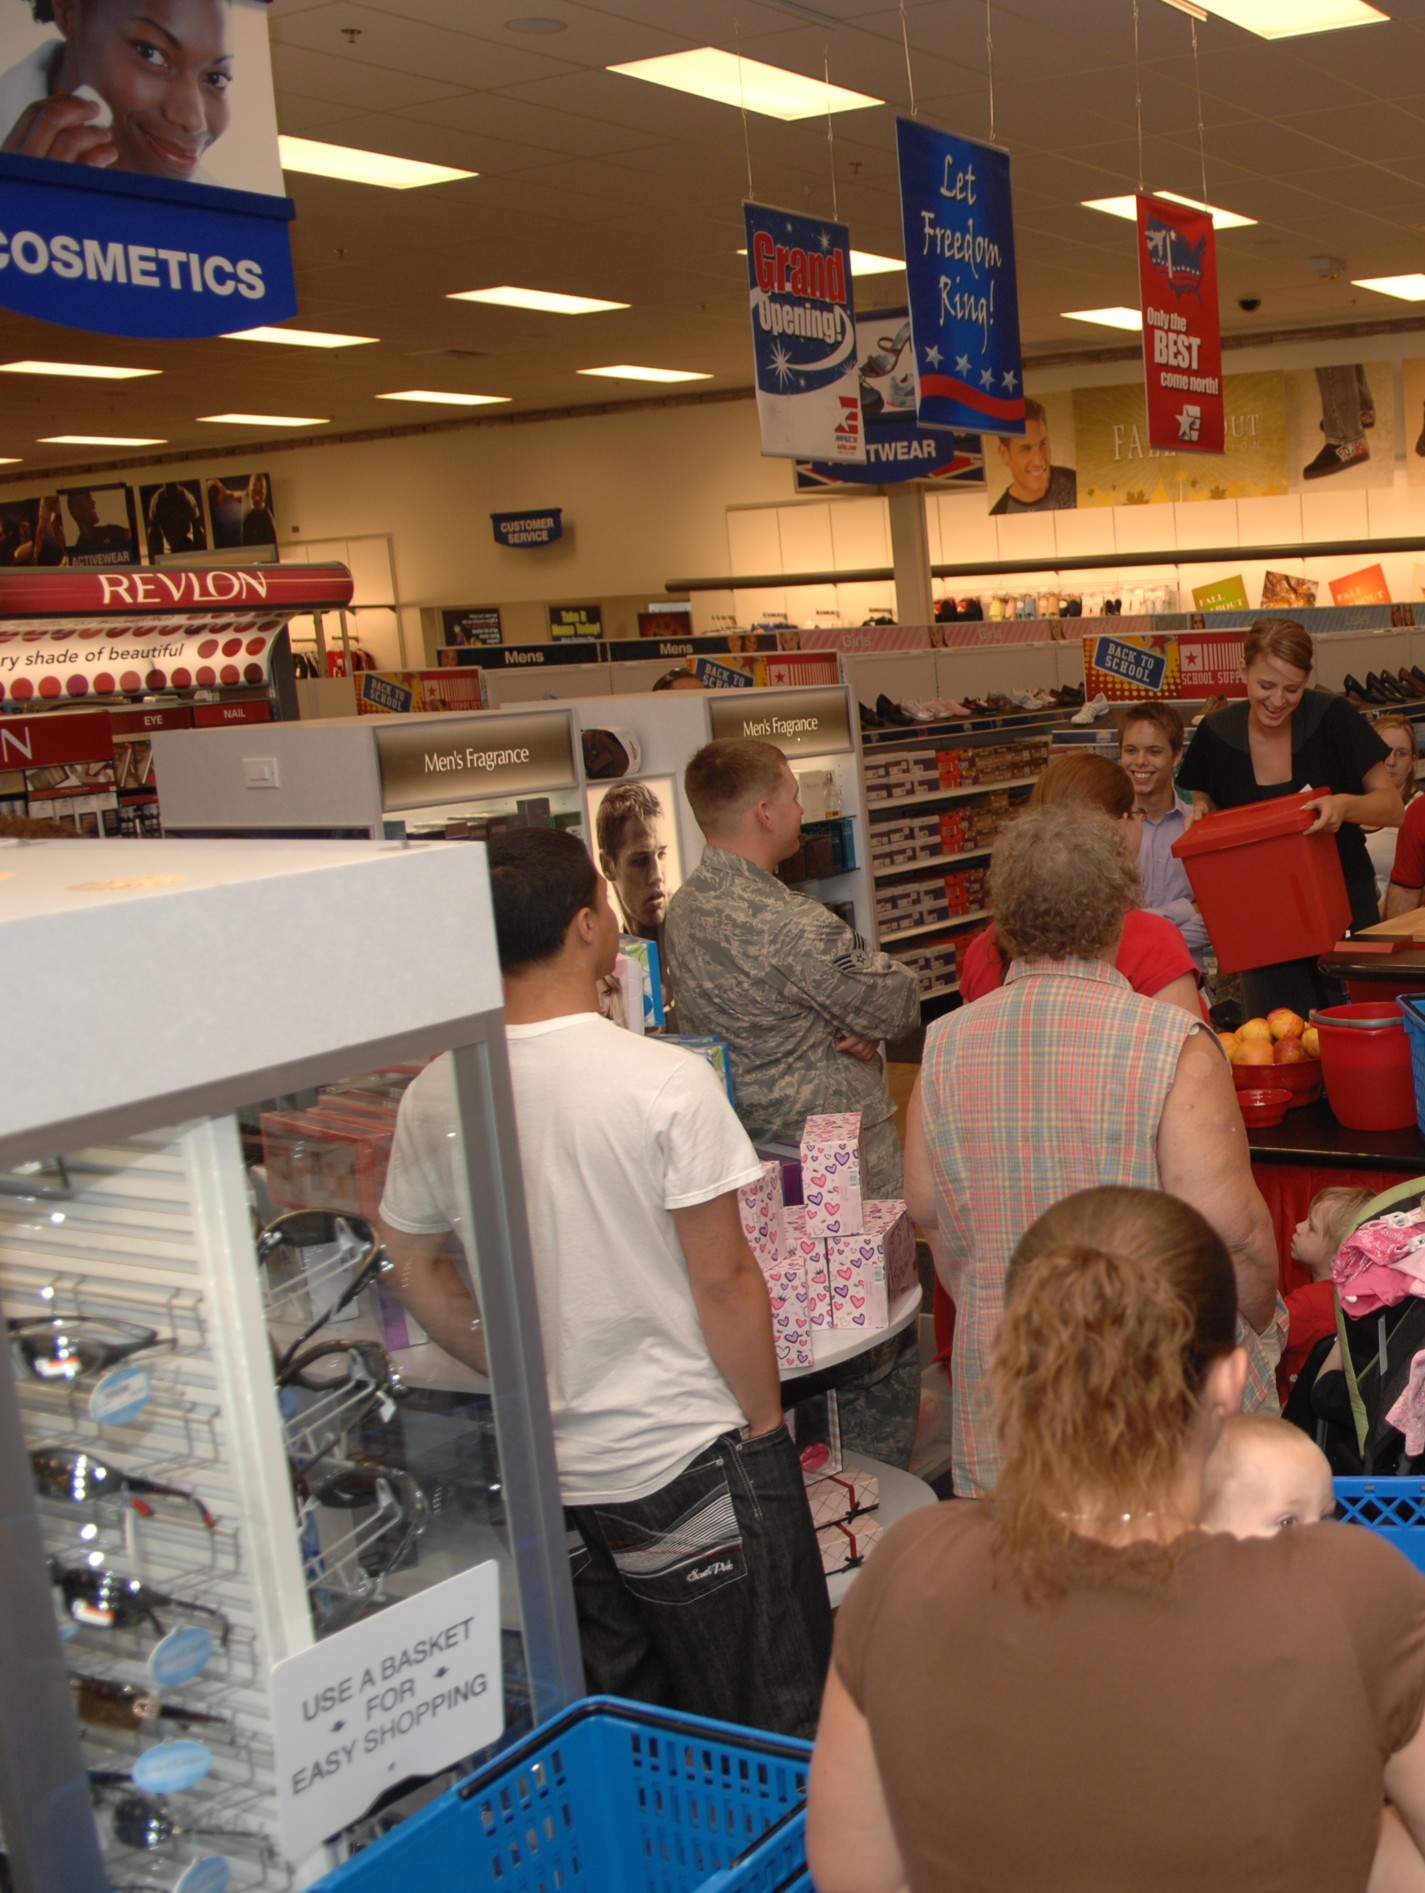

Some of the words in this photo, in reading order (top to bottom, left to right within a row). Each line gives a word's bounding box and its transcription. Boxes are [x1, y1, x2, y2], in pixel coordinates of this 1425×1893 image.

[940, 154, 976, 206] Let
[921, 210, 1002, 279] Freedom
[753, 231, 847, 304] Grand
[758, 297, 843, 345] Opening!
[939, 275, 994, 355] Ring!
[1147, 306, 1169, 331] Only
[1170, 313, 1187, 332] the
[1154, 329, 1201, 371] BEST
[1160, 371, 1189, 391] come
[1190, 376, 1219, 395] north!
[866, 438, 937, 463] TWEAR
[500, 517, 554, 534] CUSTOMER
[507, 530, 549, 545] SERVICE
[71, 551, 130, 567] ACTIVEWEAR
[98, 571, 268, 604] REVLON
[660, 642, 693, 656] Mens
[842, 635, 872, 648] Girls
[25, 649, 79, 667] shade
[85, 646, 104, 662] of
[108, 643, 184, 662] beautiful
[505, 650, 545, 666] Mens
[1107, 643, 1137, 664] BACK
[1141, 655, 1154, 670] TO
[705, 663, 728, 681] BACK
[733, 674, 745, 687] TO
[1105, 655, 1150, 682] SCHOOL
[1181, 672, 1214, 686] SCHOOL
[1218, 671, 1247, 685] SUPP
[371, 678, 392, 696] BACK
[395, 689, 406, 701] TO
[703, 675, 738, 689] SCHO
[370, 688, 403, 711] SCHOOL
[144, 715, 163, 726] EYE
[224, 708, 246, 719] NAIL
[743, 718, 771, 738] Men's
[772, 716, 818, 737] Fragrance
[424, 750, 463, 773] Men's
[466, 748, 530, 771] Fragrance
[302, 1676, 353, 1722] USE
[359, 1668, 376, 1693] A
[381, 1616, 475, 1682] BASKET
[366, 1678, 415, 1721] FOR
[291, 1739, 357, 1796] EASY
[363, 1673, 488, 1753] SHOPPING
